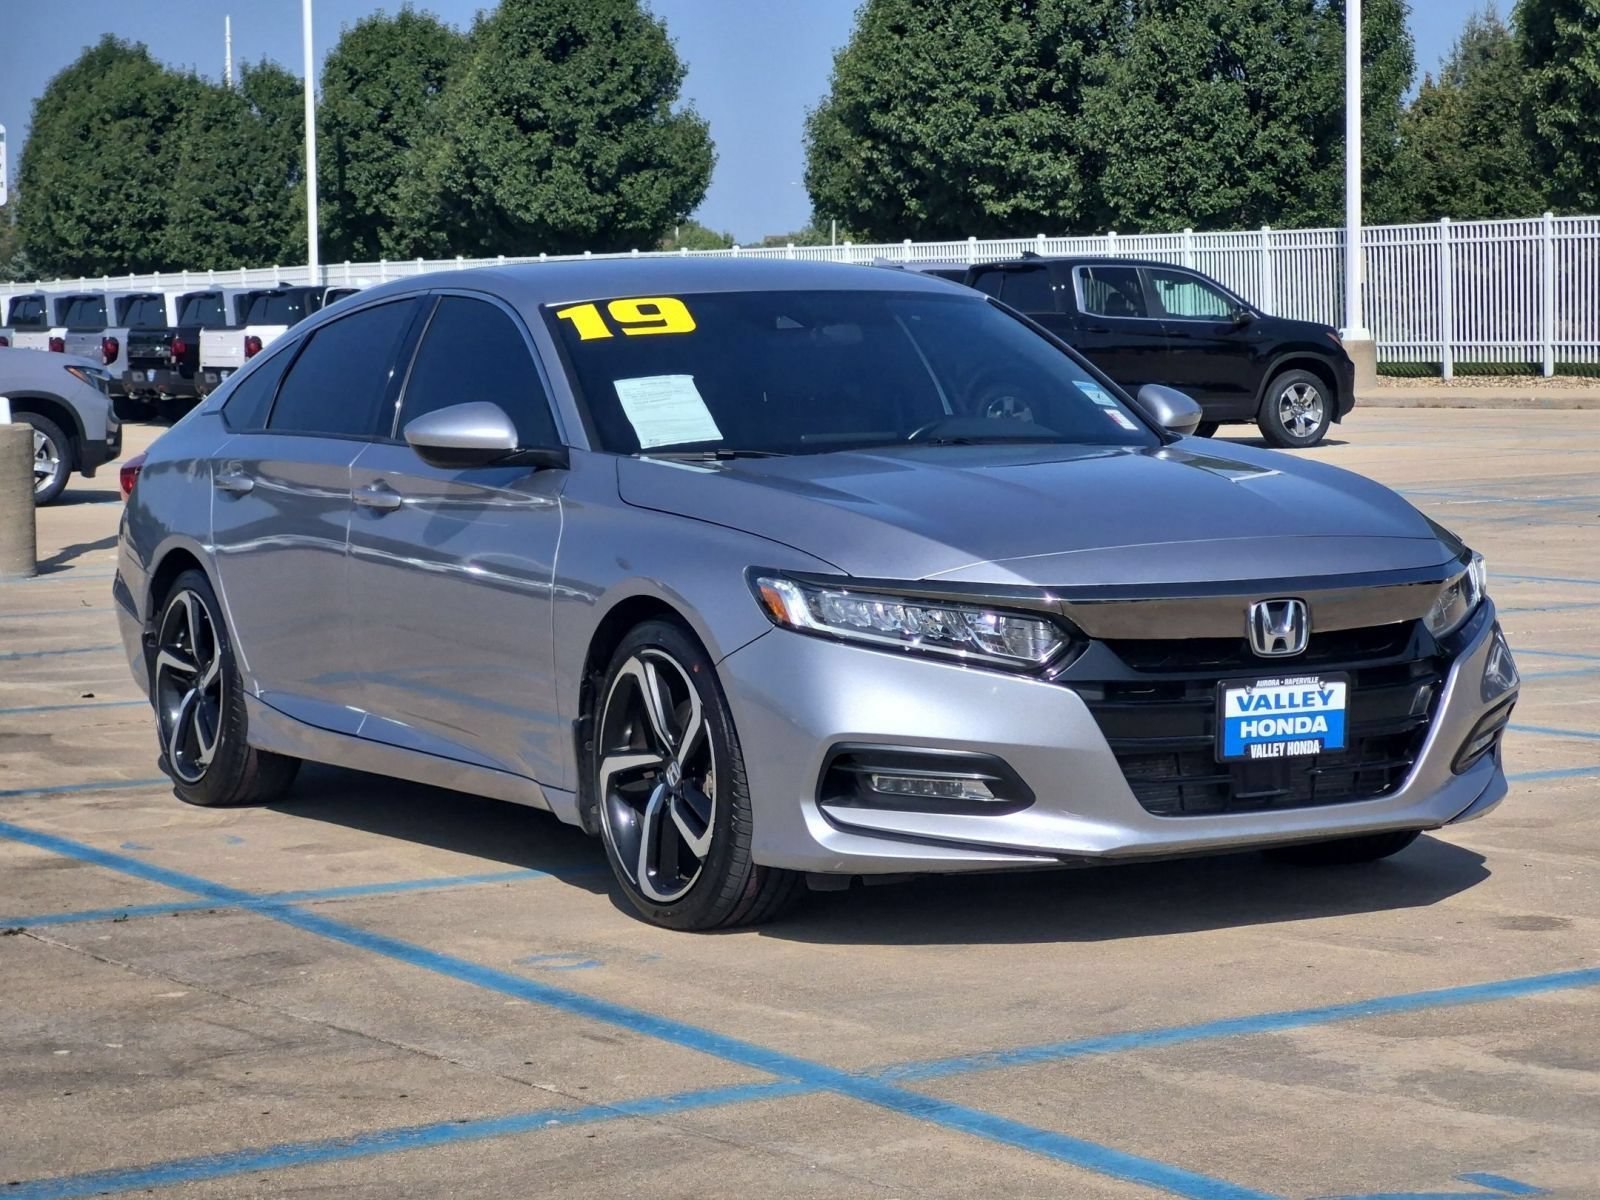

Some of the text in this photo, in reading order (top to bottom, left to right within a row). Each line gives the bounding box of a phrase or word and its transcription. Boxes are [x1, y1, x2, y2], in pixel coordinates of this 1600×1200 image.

[556, 297, 697, 341] 19
[1236, 689, 1335, 712] VALLEY
[1240, 715, 1329, 739] HONDA
[1250, 739, 1321, 759] VALLEY HONDA
